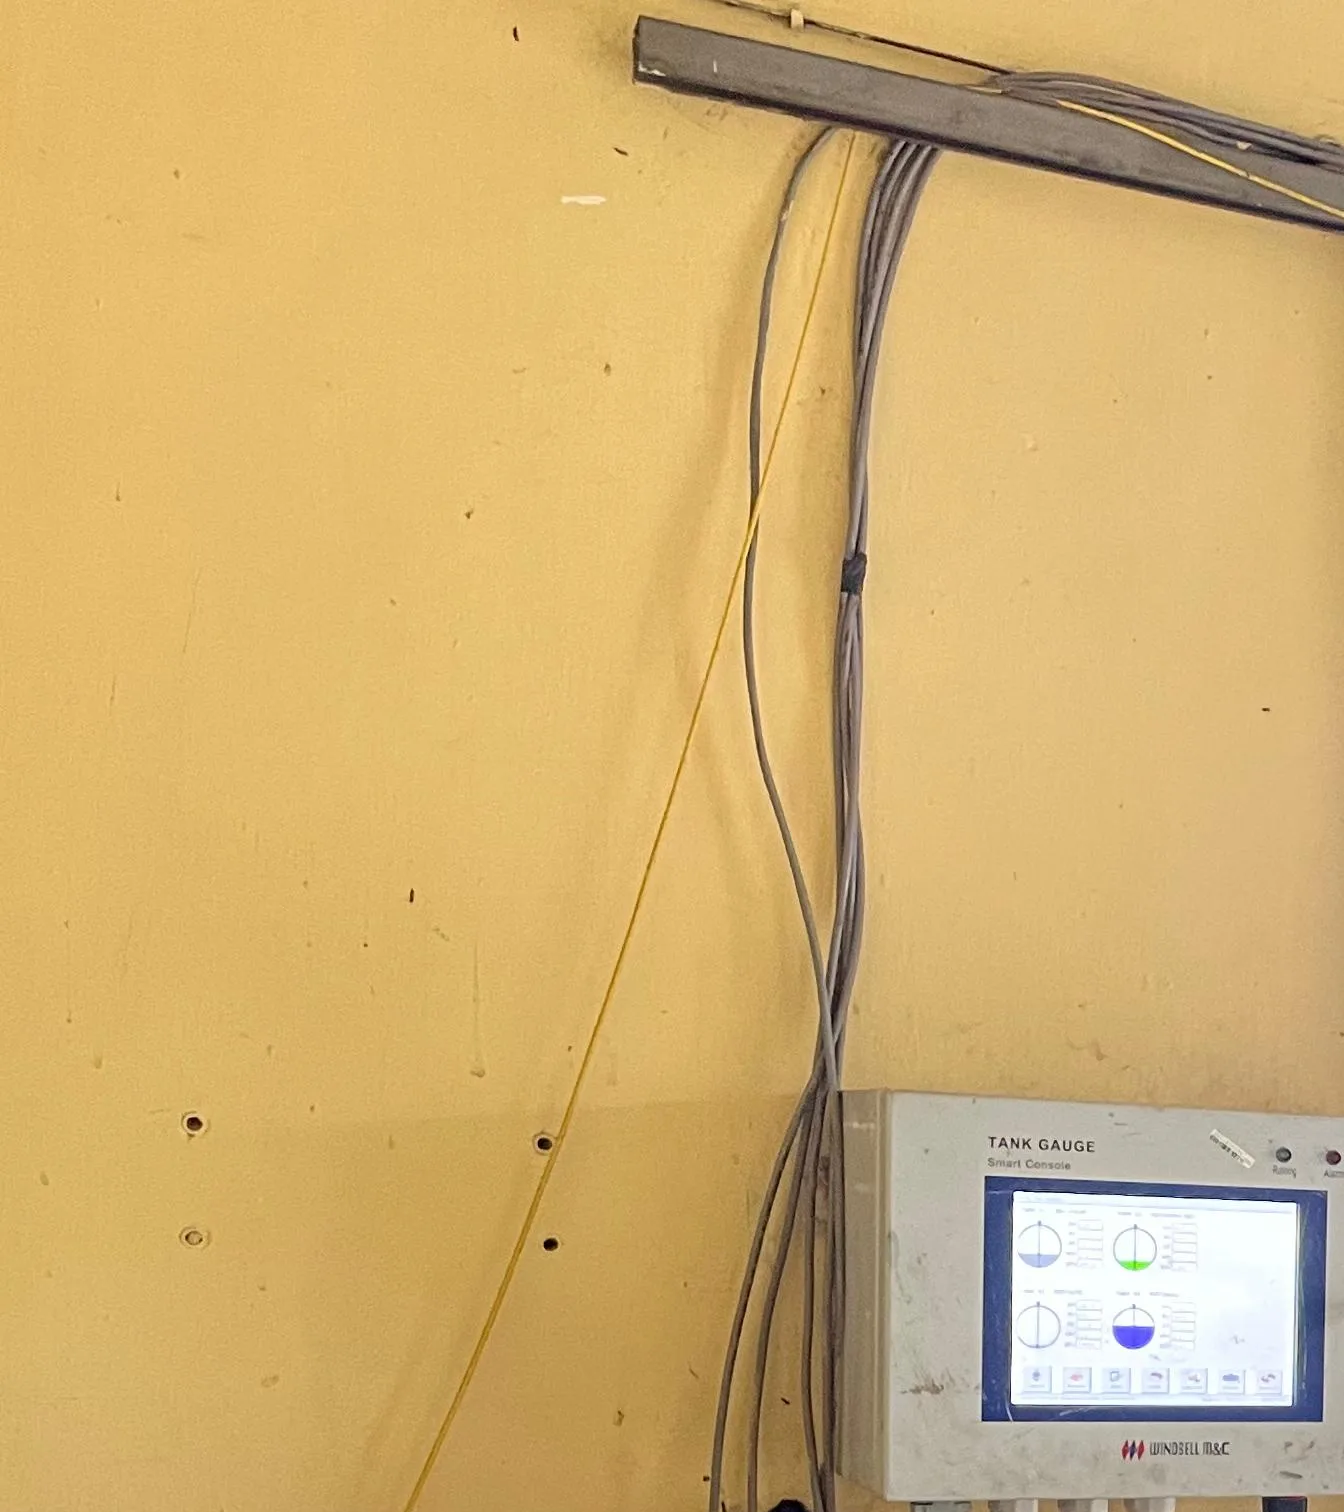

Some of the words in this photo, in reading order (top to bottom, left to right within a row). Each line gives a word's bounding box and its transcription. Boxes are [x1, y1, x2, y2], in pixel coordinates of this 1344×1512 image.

[988, 1136, 1032, 1150] TANK
[1038, 1138, 1096, 1153] GAUGE
[987, 1157, 1021, 1169] Smart
[1025, 1158, 1071, 1170] Console
